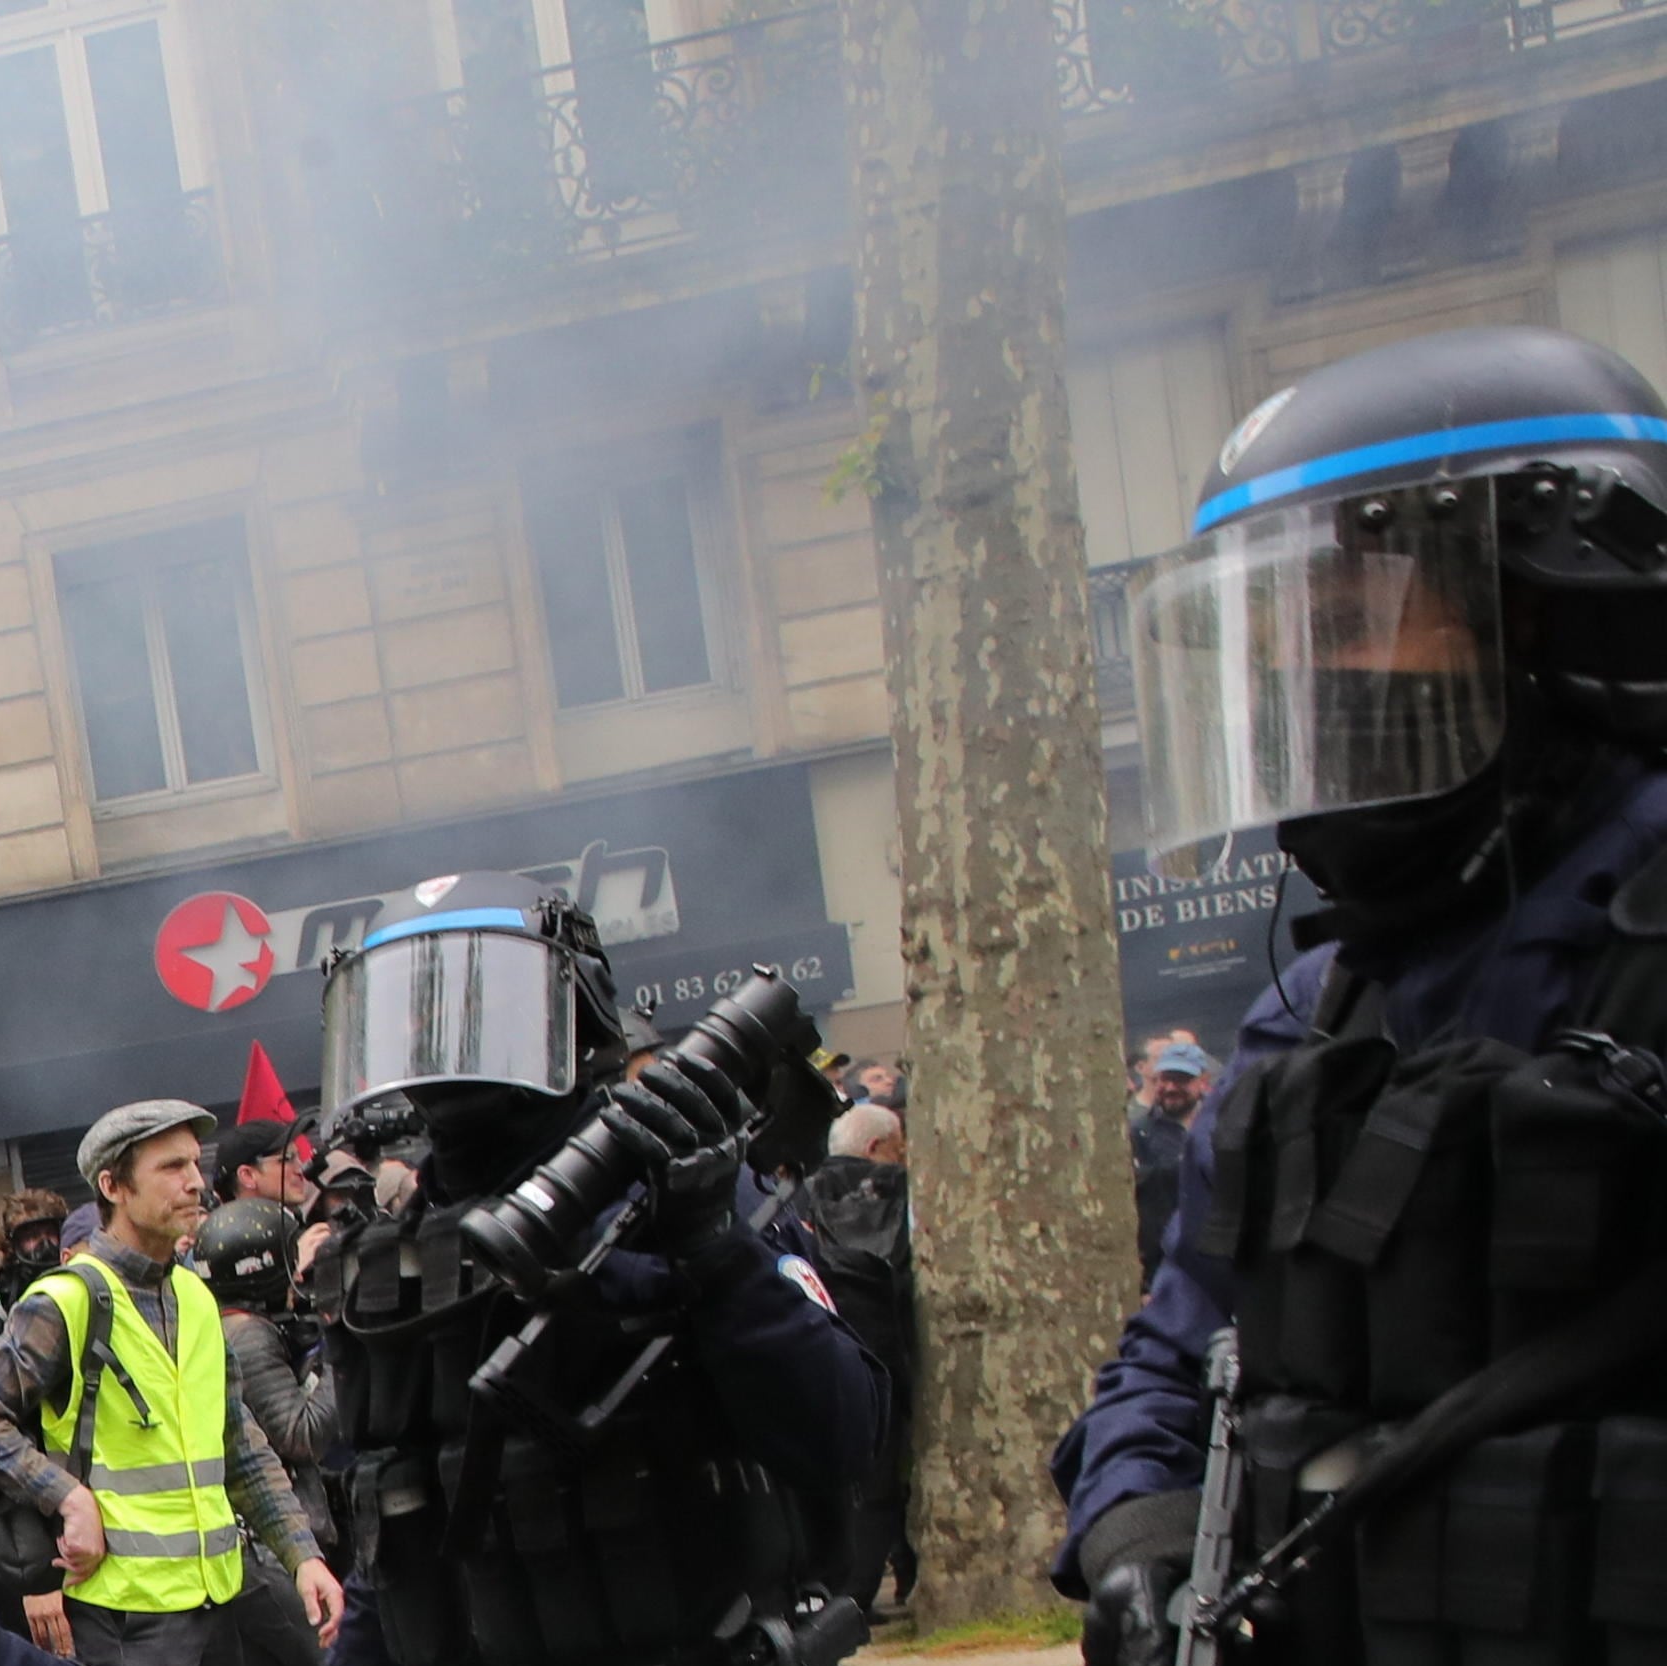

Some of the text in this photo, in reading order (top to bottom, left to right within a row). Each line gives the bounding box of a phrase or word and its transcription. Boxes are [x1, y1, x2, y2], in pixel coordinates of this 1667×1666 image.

[1119, 883, 1278, 933] DE BIENS
[635, 983, 666, 1006] 01
[674, 976, 705, 1001] 83
[713, 969, 743, 994] 62
[791, 956, 824, 981] 62
